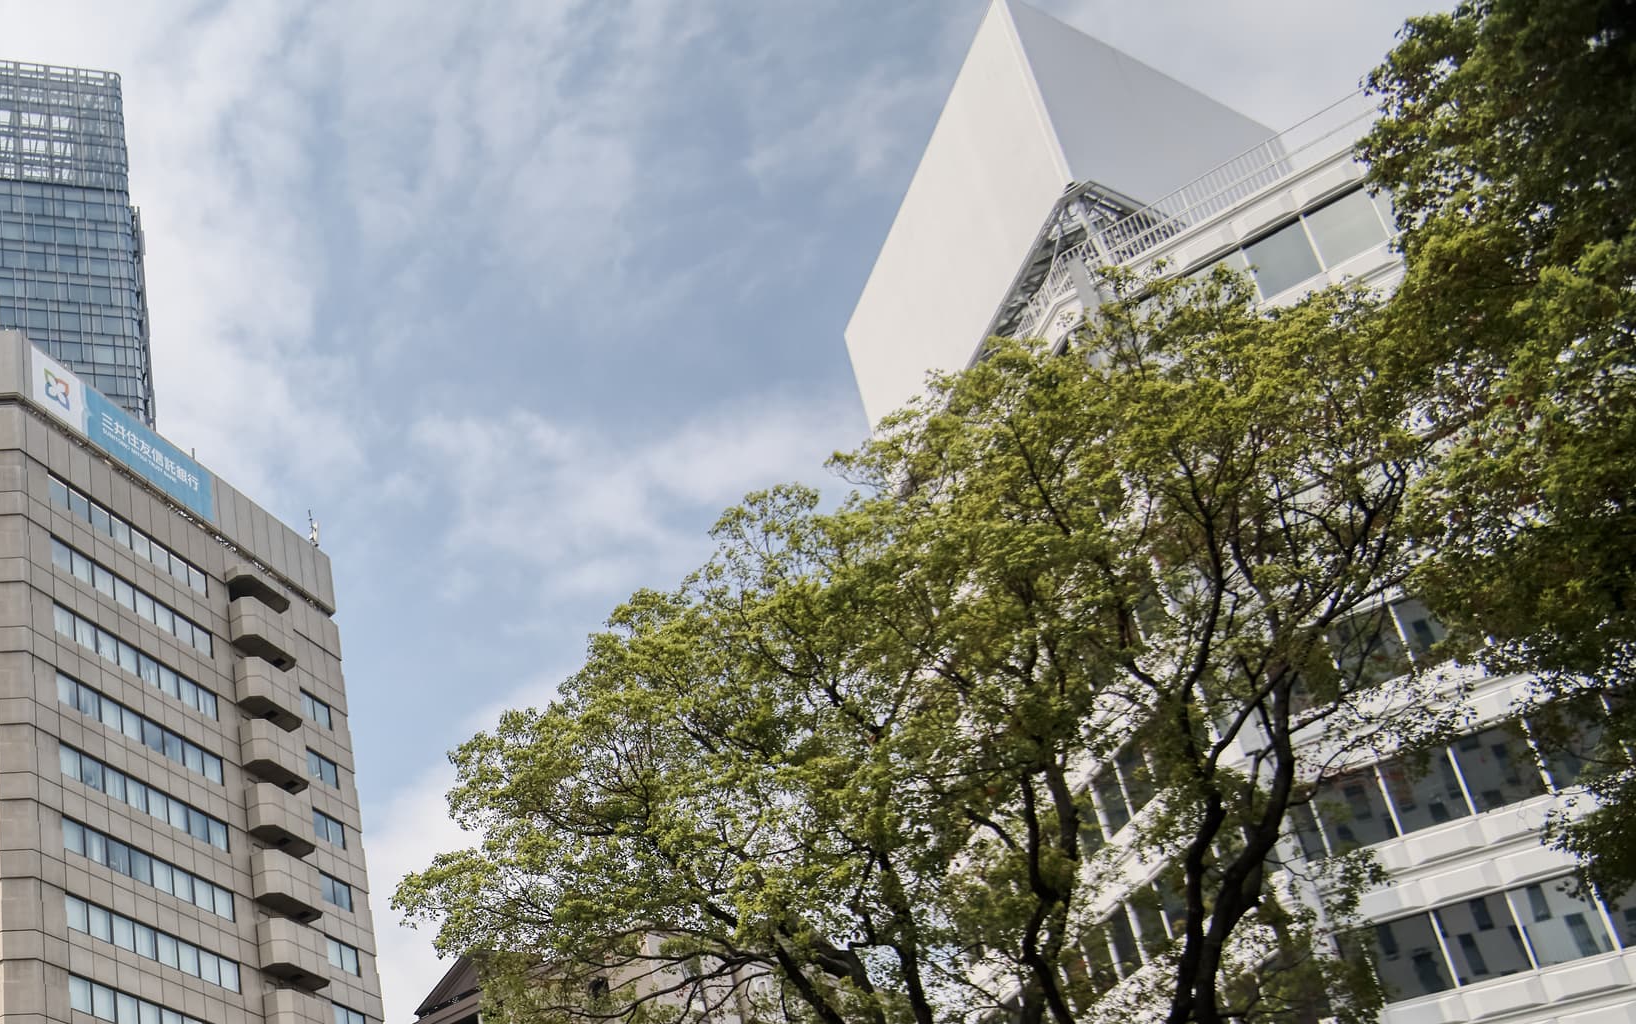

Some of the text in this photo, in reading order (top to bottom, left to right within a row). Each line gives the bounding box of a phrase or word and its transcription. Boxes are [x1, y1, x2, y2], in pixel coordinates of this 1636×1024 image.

[101, 412, 199, 492] 三井住友信託銀行
